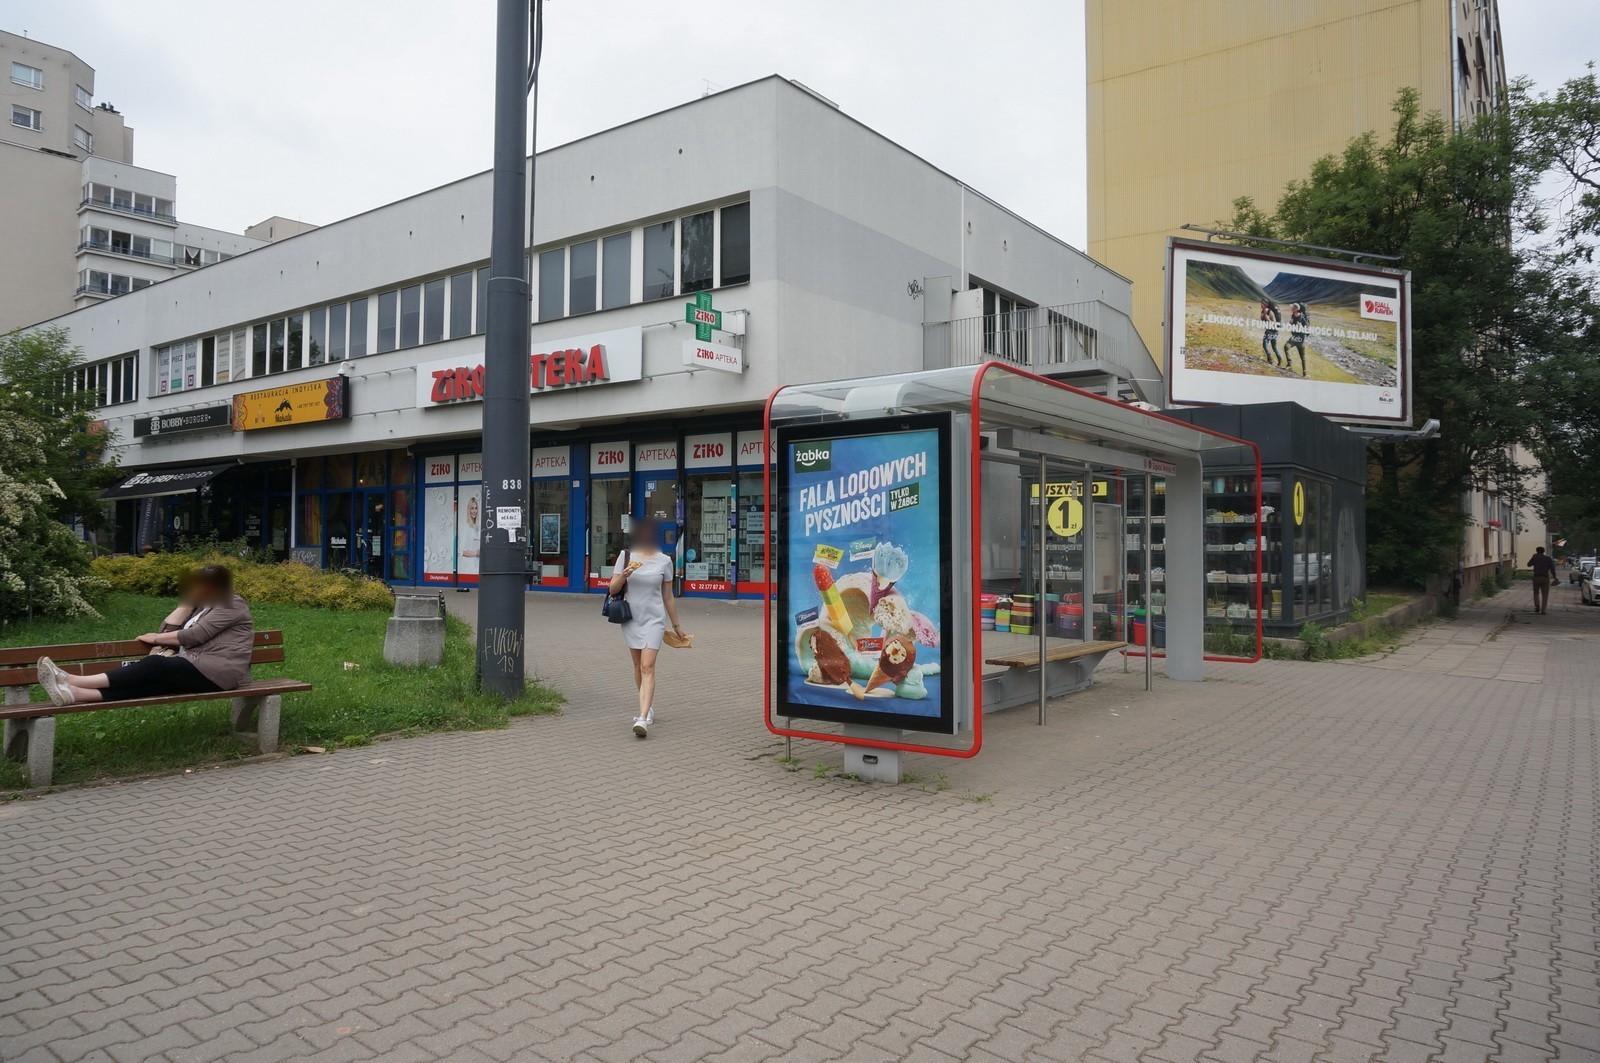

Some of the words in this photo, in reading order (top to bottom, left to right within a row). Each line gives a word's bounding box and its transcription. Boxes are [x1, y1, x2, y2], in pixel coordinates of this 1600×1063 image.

[530, 344, 610, 389] TEKA
[715, 353, 738, 365] APTEKA
[250, 389, 289, 401] RESTAURACJA
[292, 383, 322, 395] INDYJSKA
[161, 416, 183, 429] BOBBY
[638, 448, 678, 461] APTEKA
[795, 449, 830, 462] żabka
[461, 463, 482, 473] APTEK
[535, 456, 567, 468] APTEKA
[502, 479, 522, 490] 838
[800, 480, 836, 513] FALA
[839, 451, 927, 500] LODOWYCH
[1045, 483, 1099, 496] SZYTO
[890, 486, 910, 501] TYLKO
[805, 491, 887, 537] PYSZNOŚCI
[1058, 500, 1069, 529] 1
